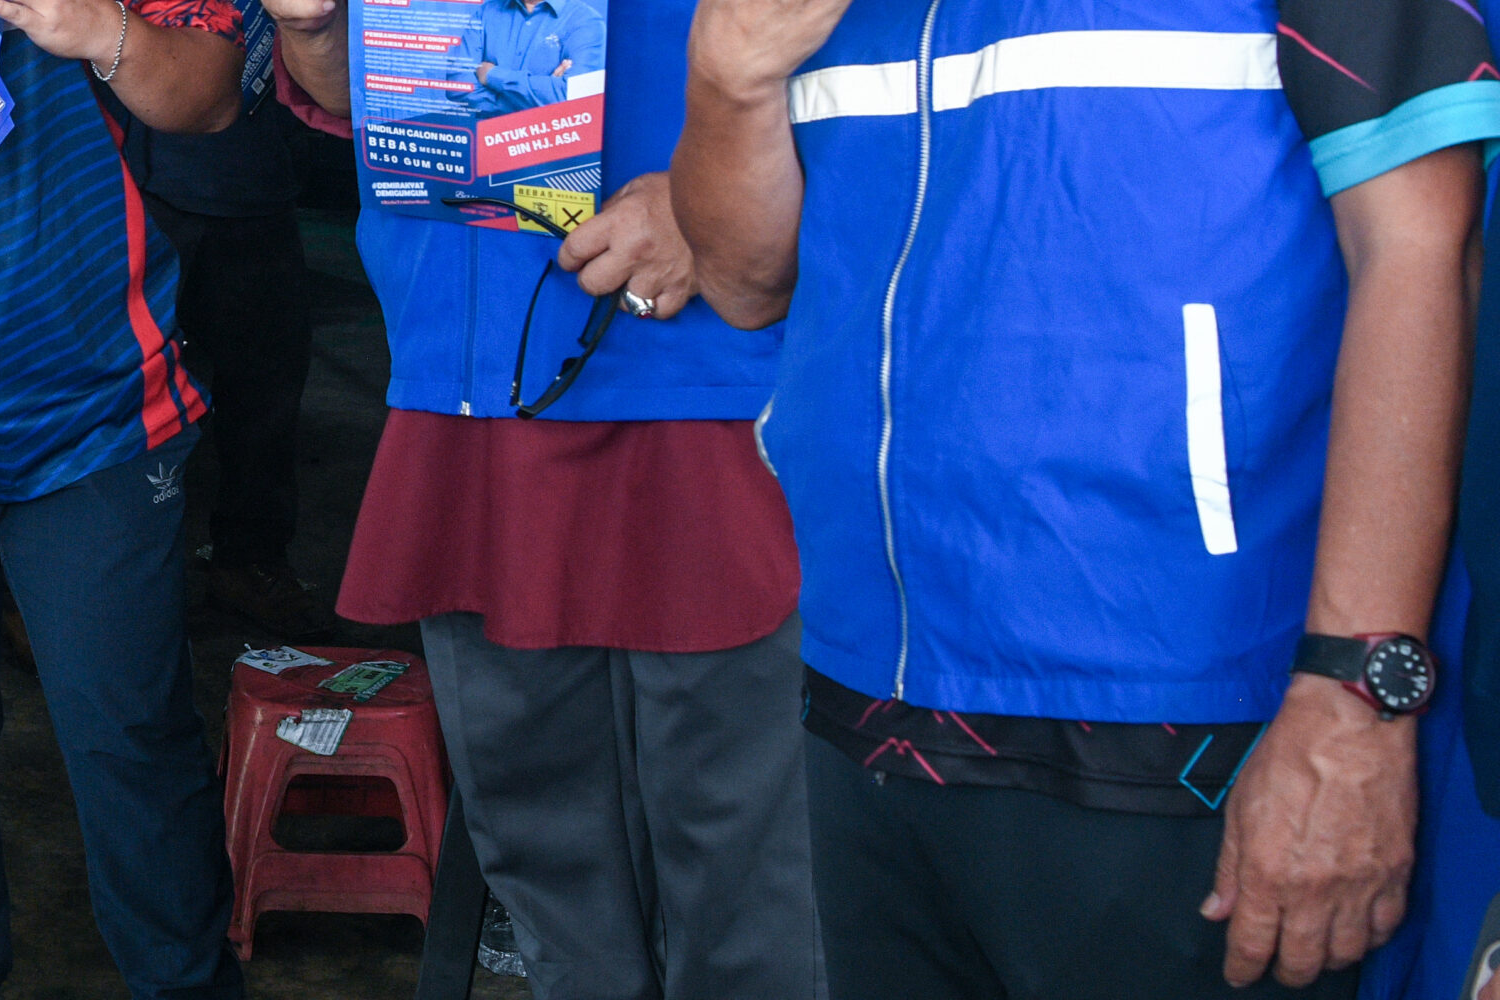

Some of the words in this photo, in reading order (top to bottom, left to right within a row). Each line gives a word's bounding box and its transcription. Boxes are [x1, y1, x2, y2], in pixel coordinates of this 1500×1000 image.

[366, 123, 406, 136] UNDILAH
[405, 128, 439, 140] CALON
[483, 126, 529, 147] DATUK
[528, 120, 551, 136] HJ.
[550, 110, 593, 131] SALZO
[367, 136, 418, 153] BEBAS
[418, 146, 447, 156] MESRA
[506, 141, 532, 157] BIN
[530, 135, 553, 151] HJ.
[552, 129, 581, 146] ASA
[368, 151, 399, 163] N.50
[402, 156, 432, 169] GUM
[435, 161, 465, 174] GUM
[153, 486, 179, 504] adidas
